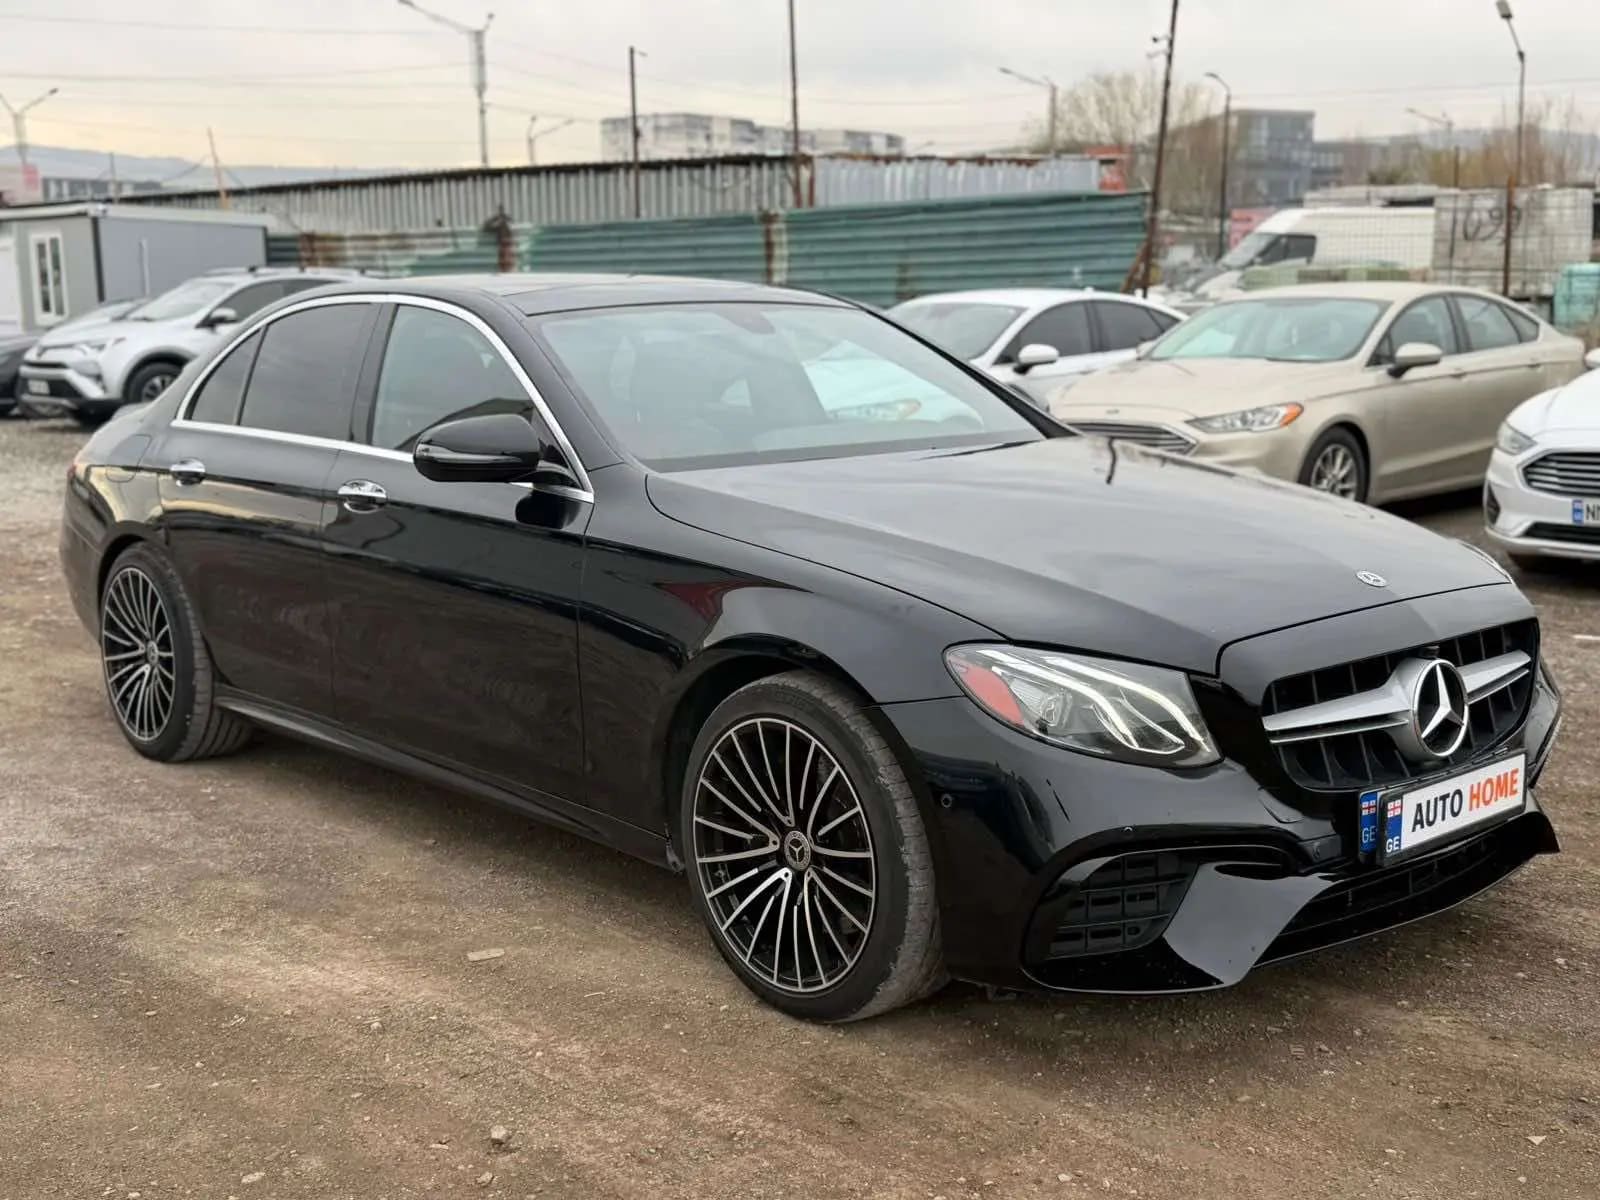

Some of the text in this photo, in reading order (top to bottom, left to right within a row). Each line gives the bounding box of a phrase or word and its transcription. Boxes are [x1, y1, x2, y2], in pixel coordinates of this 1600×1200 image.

[1411, 768, 1519, 833] AUTO HOME
[1361, 826, 1376, 843] GE
[1386, 836, 1400, 853] GE
